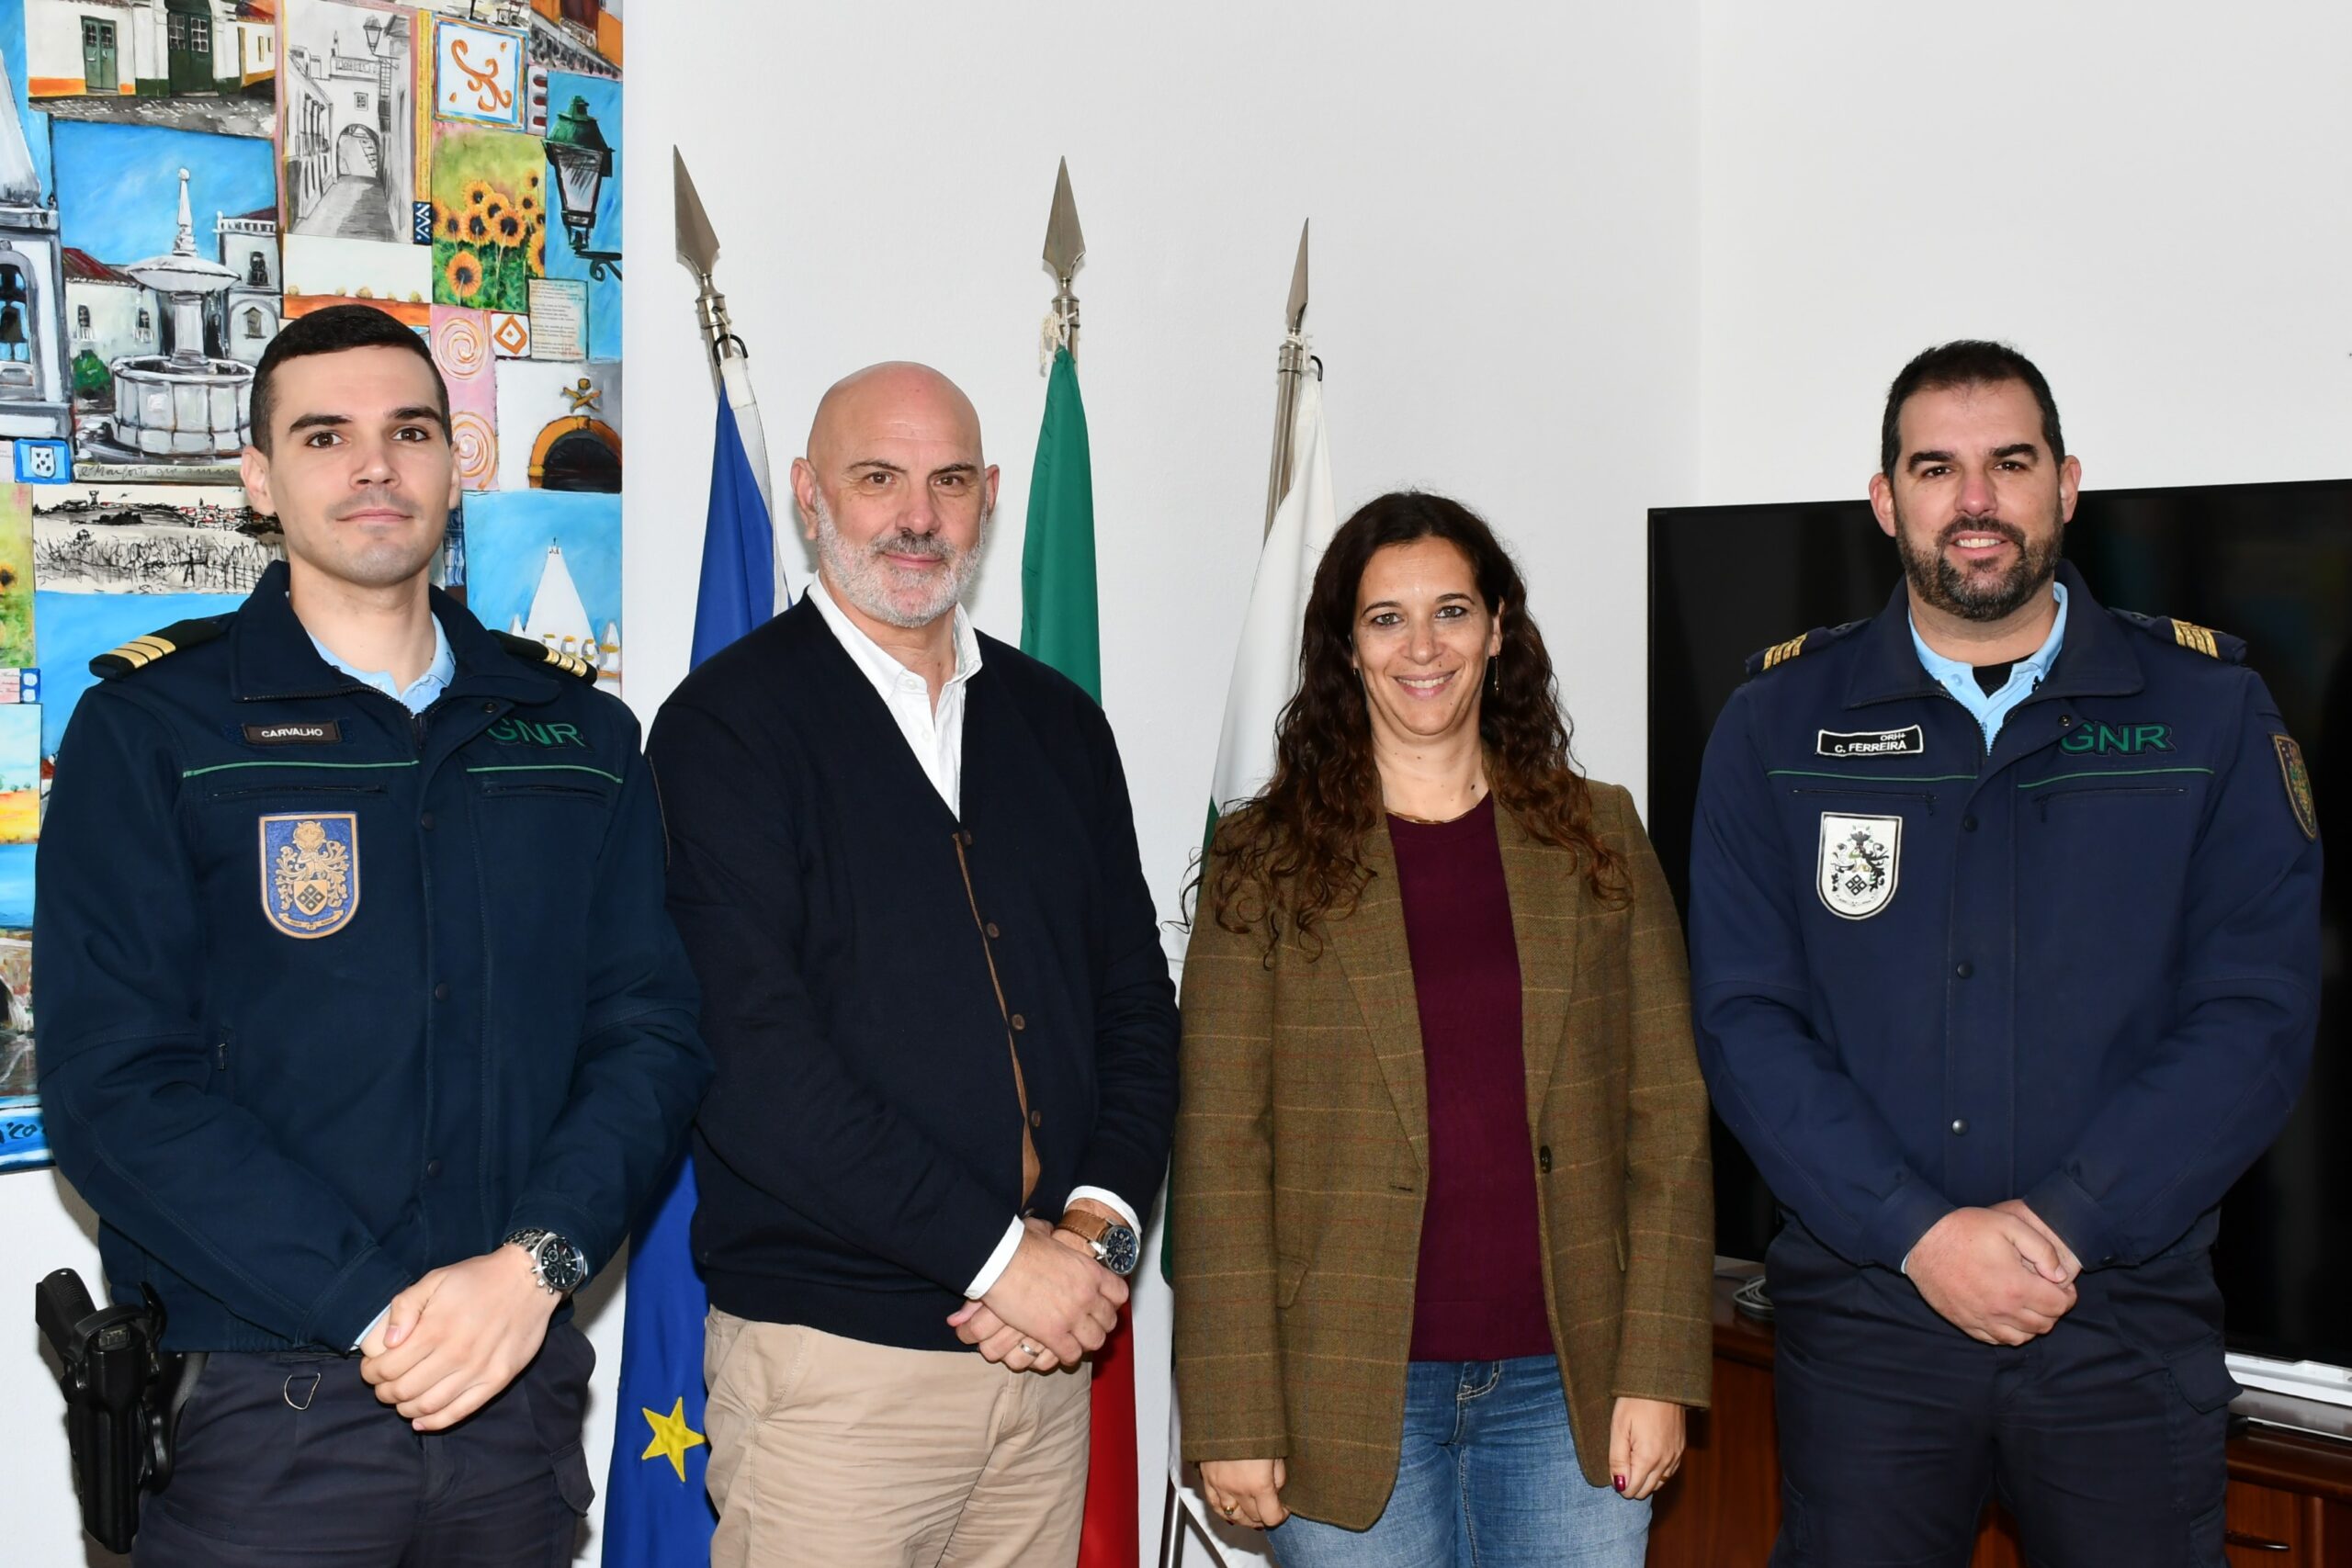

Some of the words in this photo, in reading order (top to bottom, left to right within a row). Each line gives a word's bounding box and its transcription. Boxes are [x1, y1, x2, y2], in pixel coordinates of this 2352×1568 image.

[261, 728, 323, 738] CARVALHO
[2060, 723, 2167, 752] GNR
[1834, 744, 1847, 753] C.
[1849, 739, 1907, 752] FERREIRA
